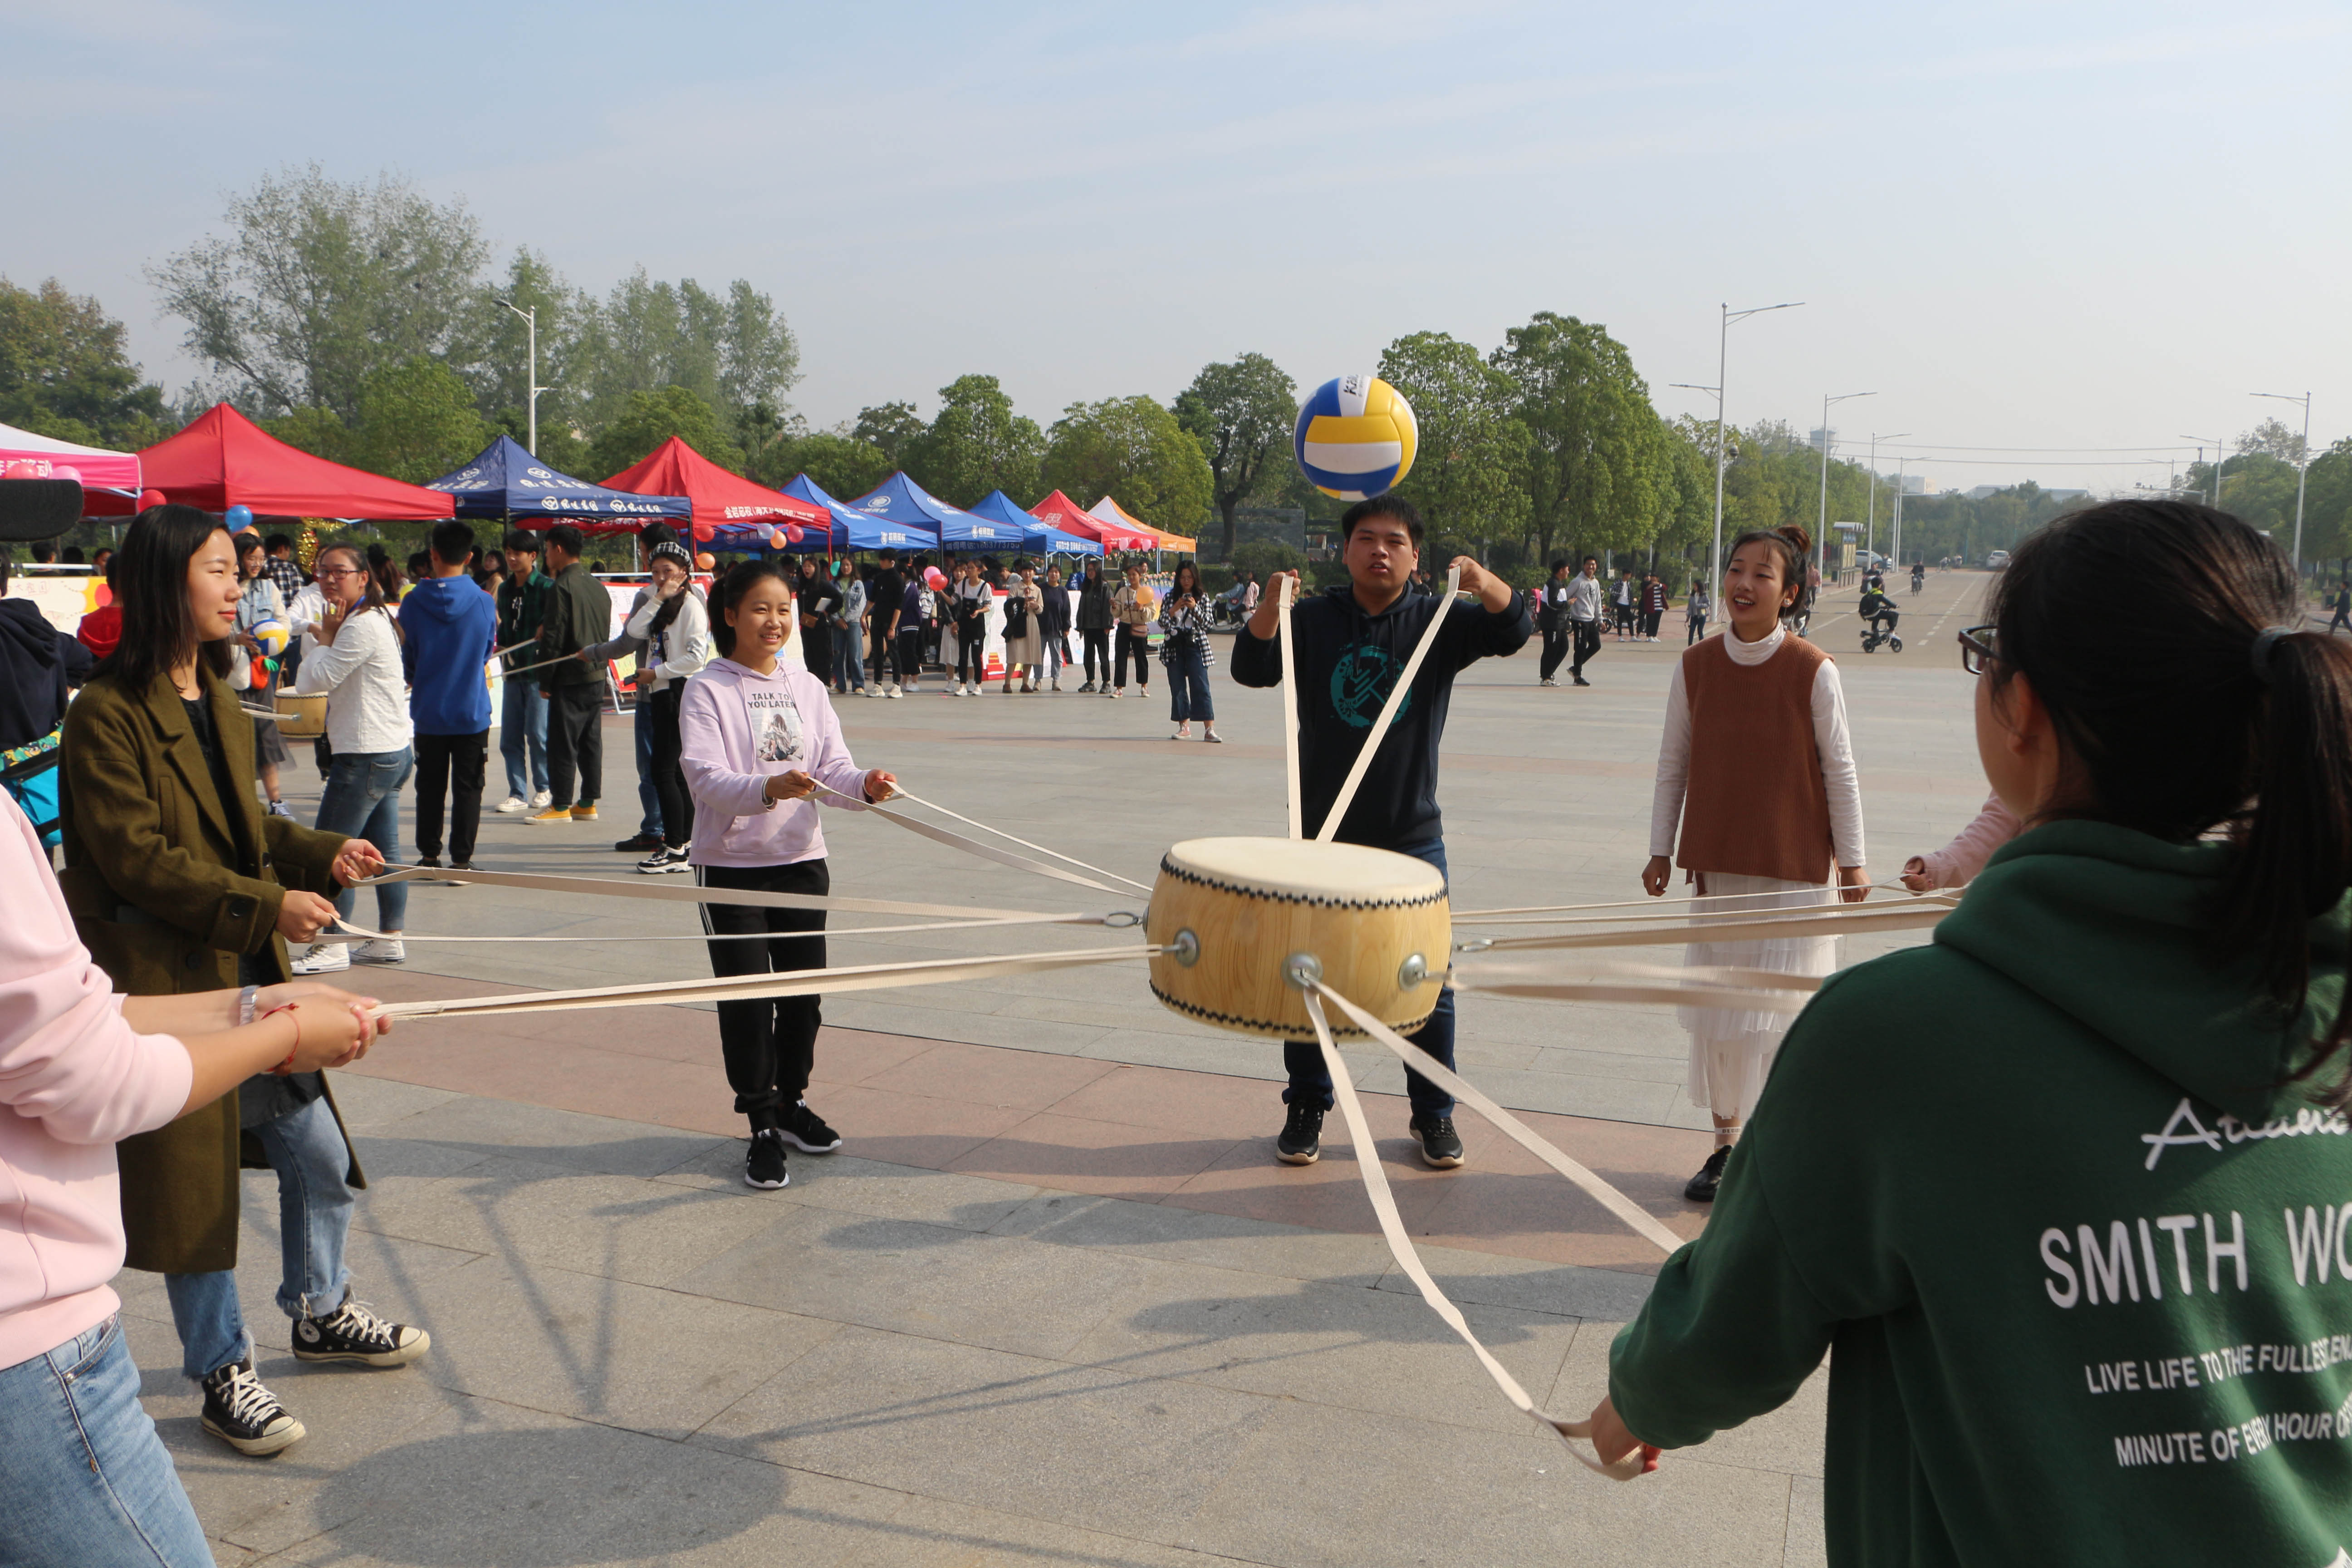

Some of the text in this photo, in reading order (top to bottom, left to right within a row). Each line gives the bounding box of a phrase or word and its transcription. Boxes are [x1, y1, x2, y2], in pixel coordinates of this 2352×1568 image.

[752, 692, 775, 701] TALK
[2039, 1210, 2248, 1309] SMITH
[2086, 1361, 2141, 1394] LIVE
[2145, 1356, 2200, 1390] LIFE
[2200, 1350, 2224, 1384] TO
[2221, 1344, 2254, 1378] THE
[2114, 1432, 2207, 1467] MINUTE
[2210, 1427, 2240, 1461] OF
[2240, 1414, 2272, 1455] EVERY
[2274, 1412, 2333, 1441] HOUR
